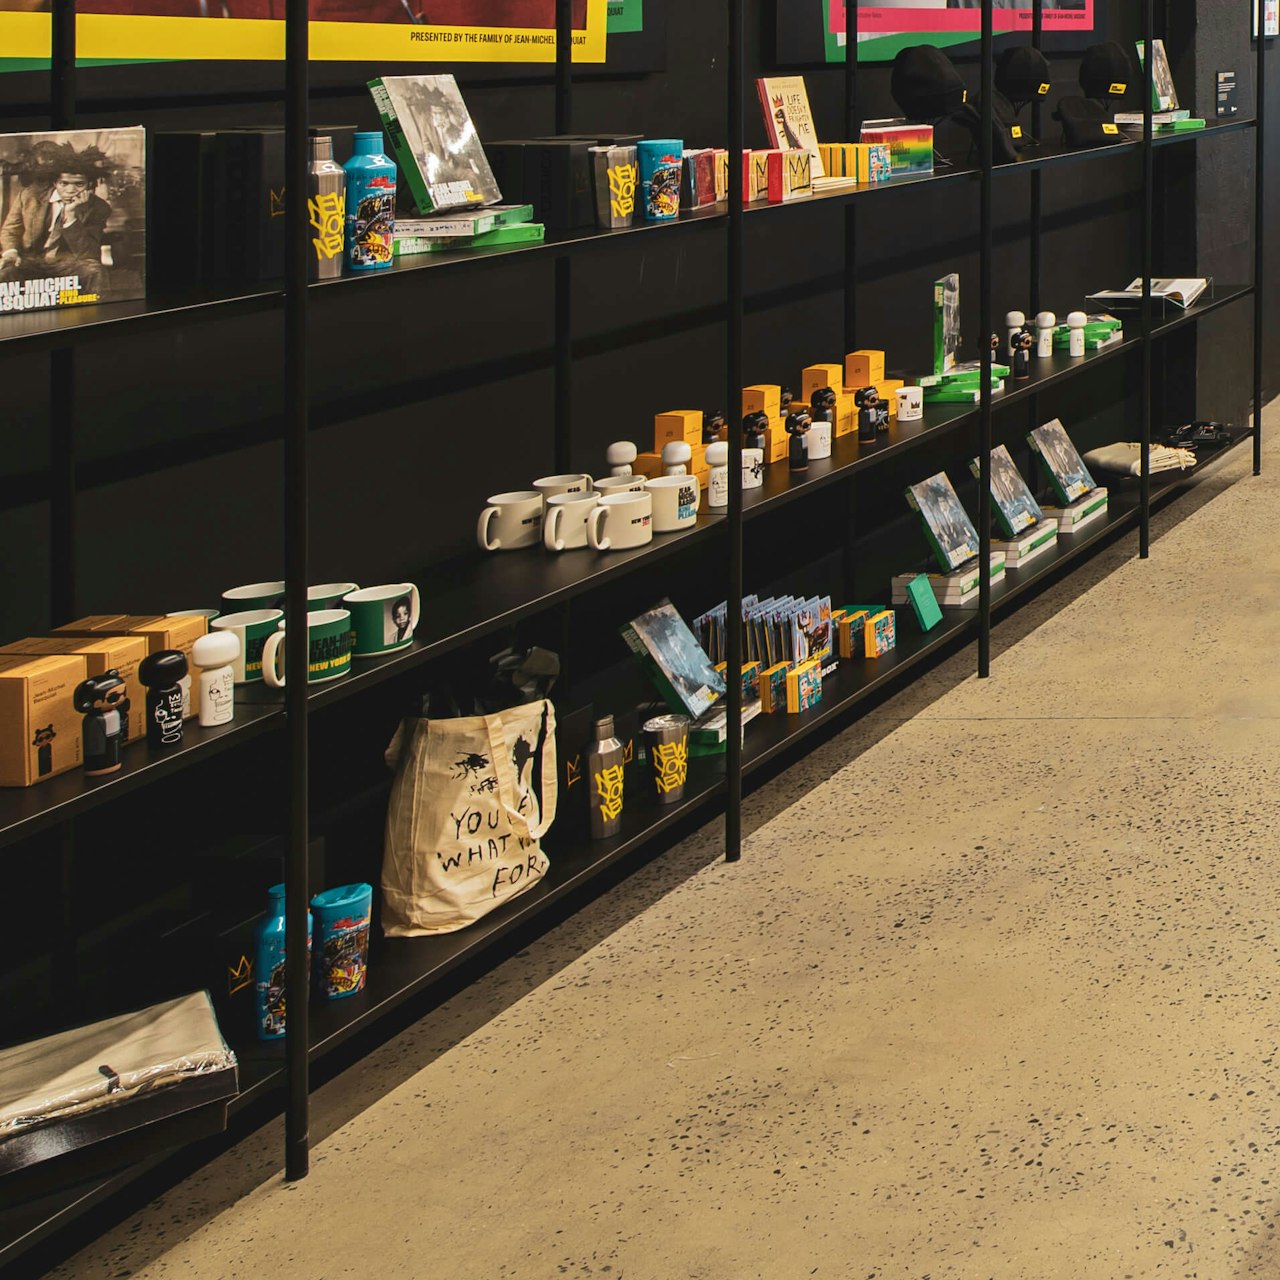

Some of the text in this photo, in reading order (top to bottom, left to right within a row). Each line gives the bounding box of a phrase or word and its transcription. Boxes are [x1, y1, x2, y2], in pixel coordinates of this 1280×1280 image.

[410, 31, 452, 42] PRESENTED
[454, 33, 462, 42] BY
[465, 33, 477, 43] THE
[479, 33, 502, 43] FAMILY
[504, 34, 513, 43] OF
[513, 34, 555, 45] JEAN-MICHEL
[0, 275, 82, 297] AN-MICHEL
[0, 291, 60, 311] ASQUIAT:
[450, 806, 499, 840] YOU
[437, 833, 512, 872] WHAT
[492, 853, 541, 898] FOR
